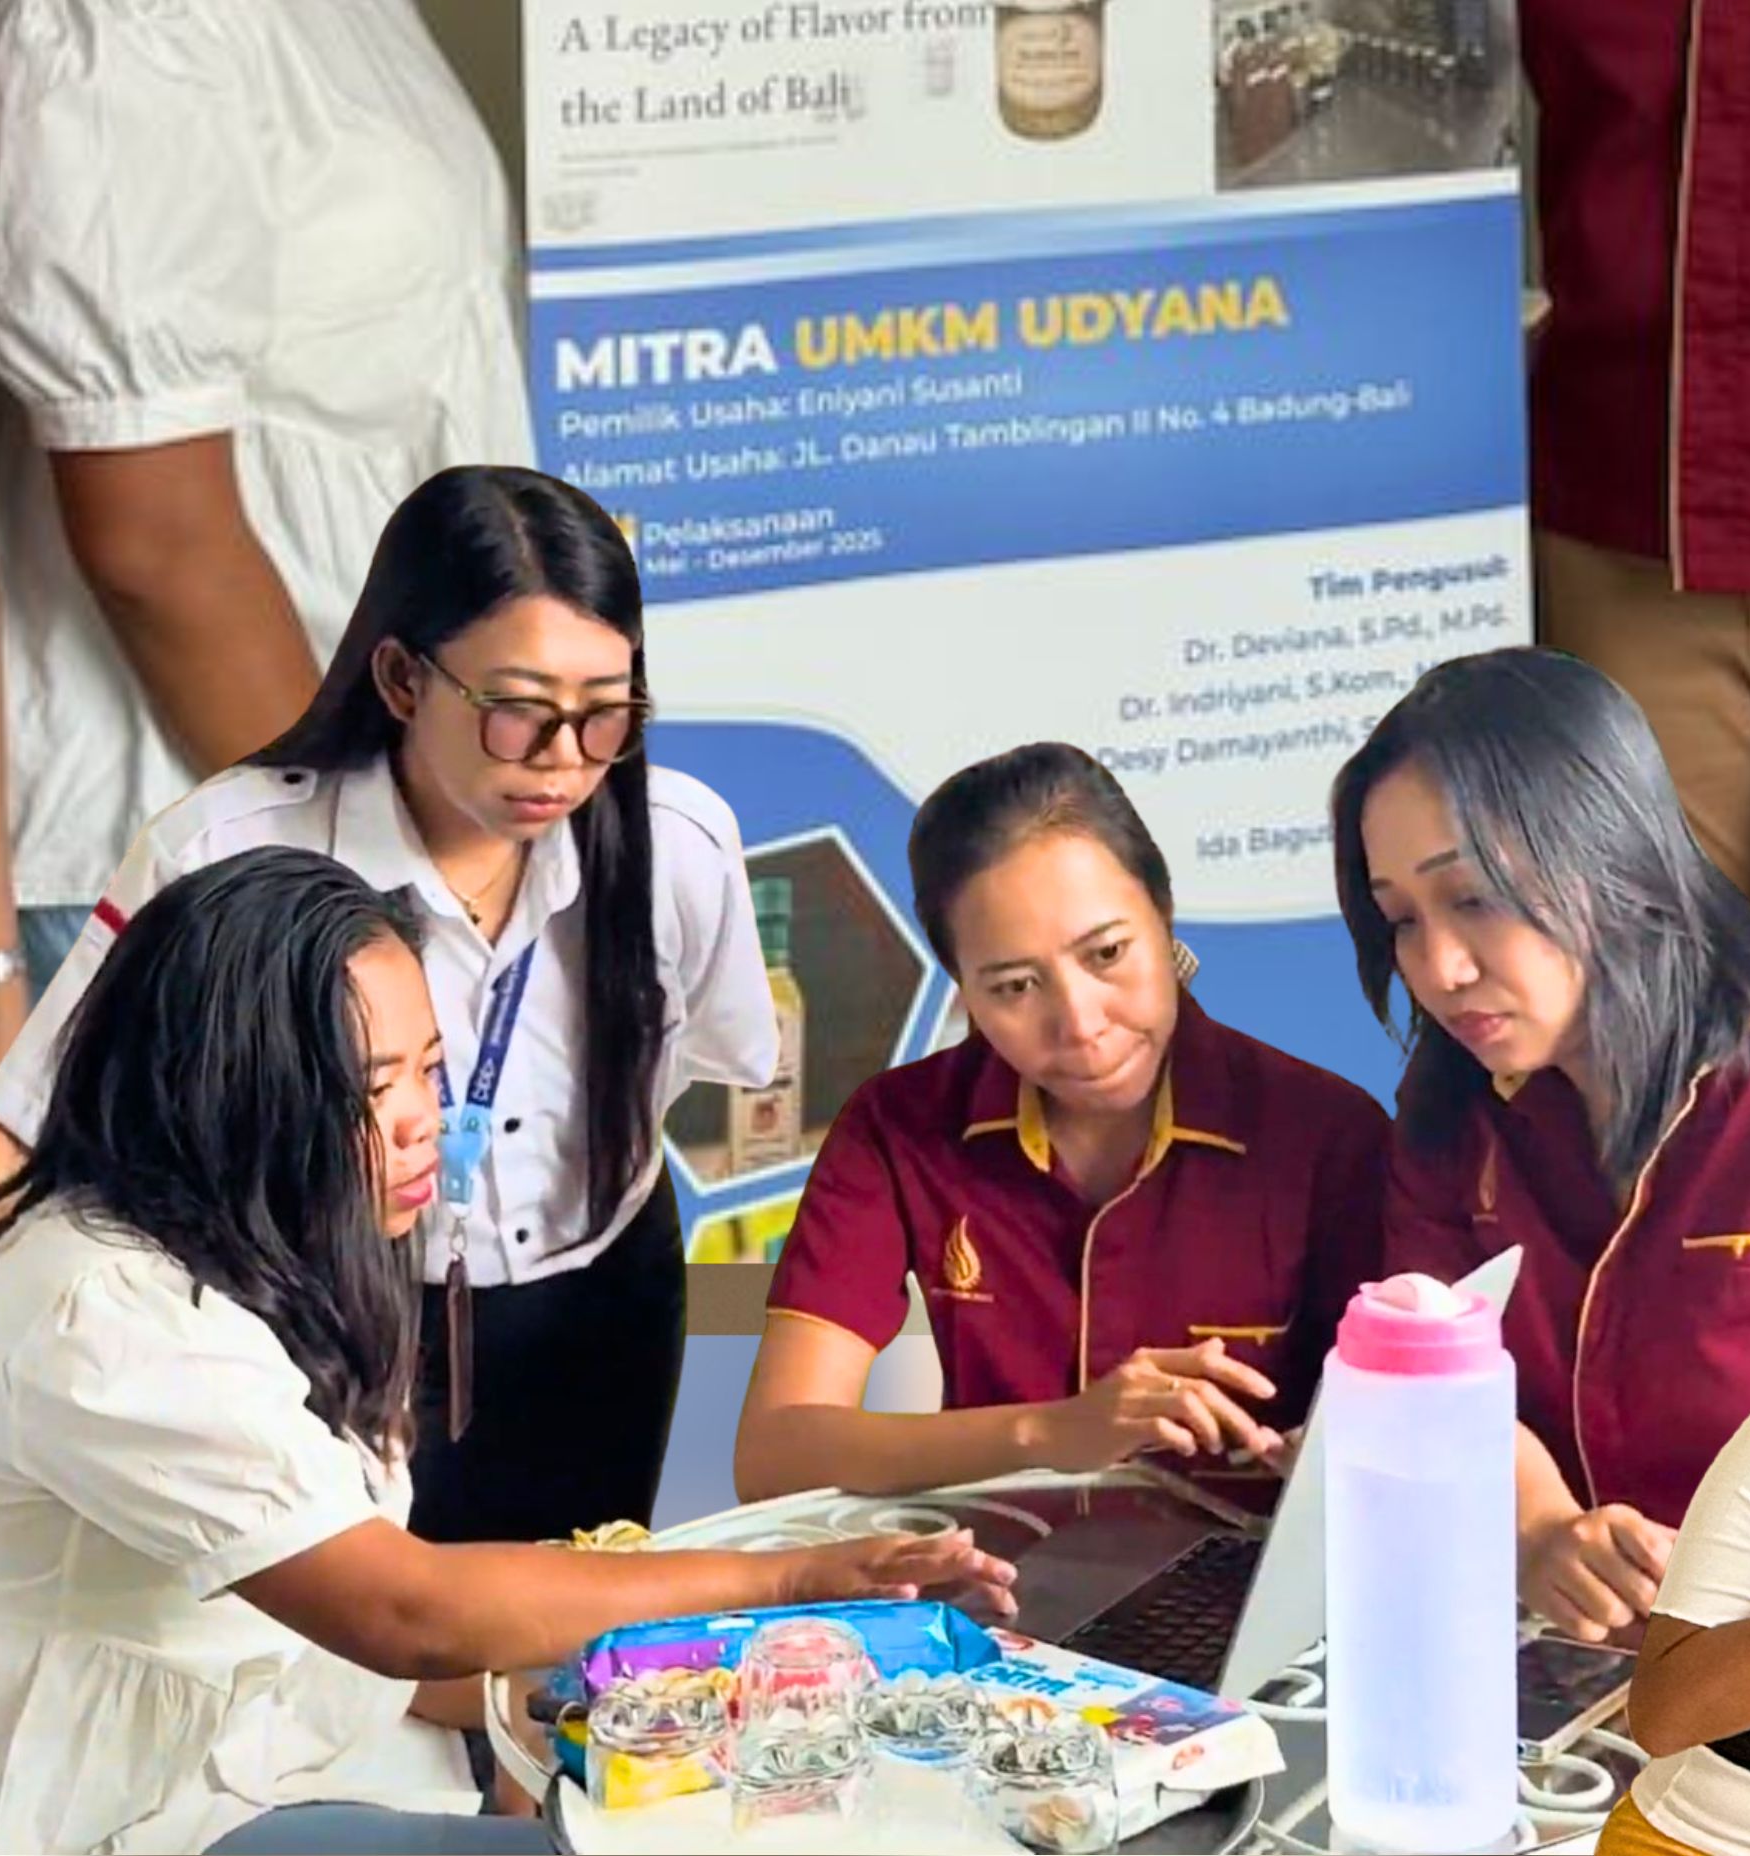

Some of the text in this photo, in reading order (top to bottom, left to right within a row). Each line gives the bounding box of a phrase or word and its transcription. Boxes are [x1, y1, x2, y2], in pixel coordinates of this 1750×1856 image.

[560, 17, 591, 53] A
[604, 15, 730, 64] Legacy
[740, 2, 783, 43] of
[790, 1, 894, 40] Flavor
[560, 88, 620, 127] the
[634, 80, 727, 125] Land
[737, 74, 780, 115] of
[555, 275, 1290, 394] MITRA UMKM UDYANA
[558, 403, 681, 441] Pemilik
[799, 382, 906, 417] Eniyani
[911, 367, 1023, 406] Susanti
[945, 410, 1125, 450] Tamblingan
[641, 505, 835, 548] Pelaksanaan
[1308, 571, 1365, 601] Tim
[1182, 638, 1225, 667] Dr.
[1118, 695, 1161, 723] Dr.
